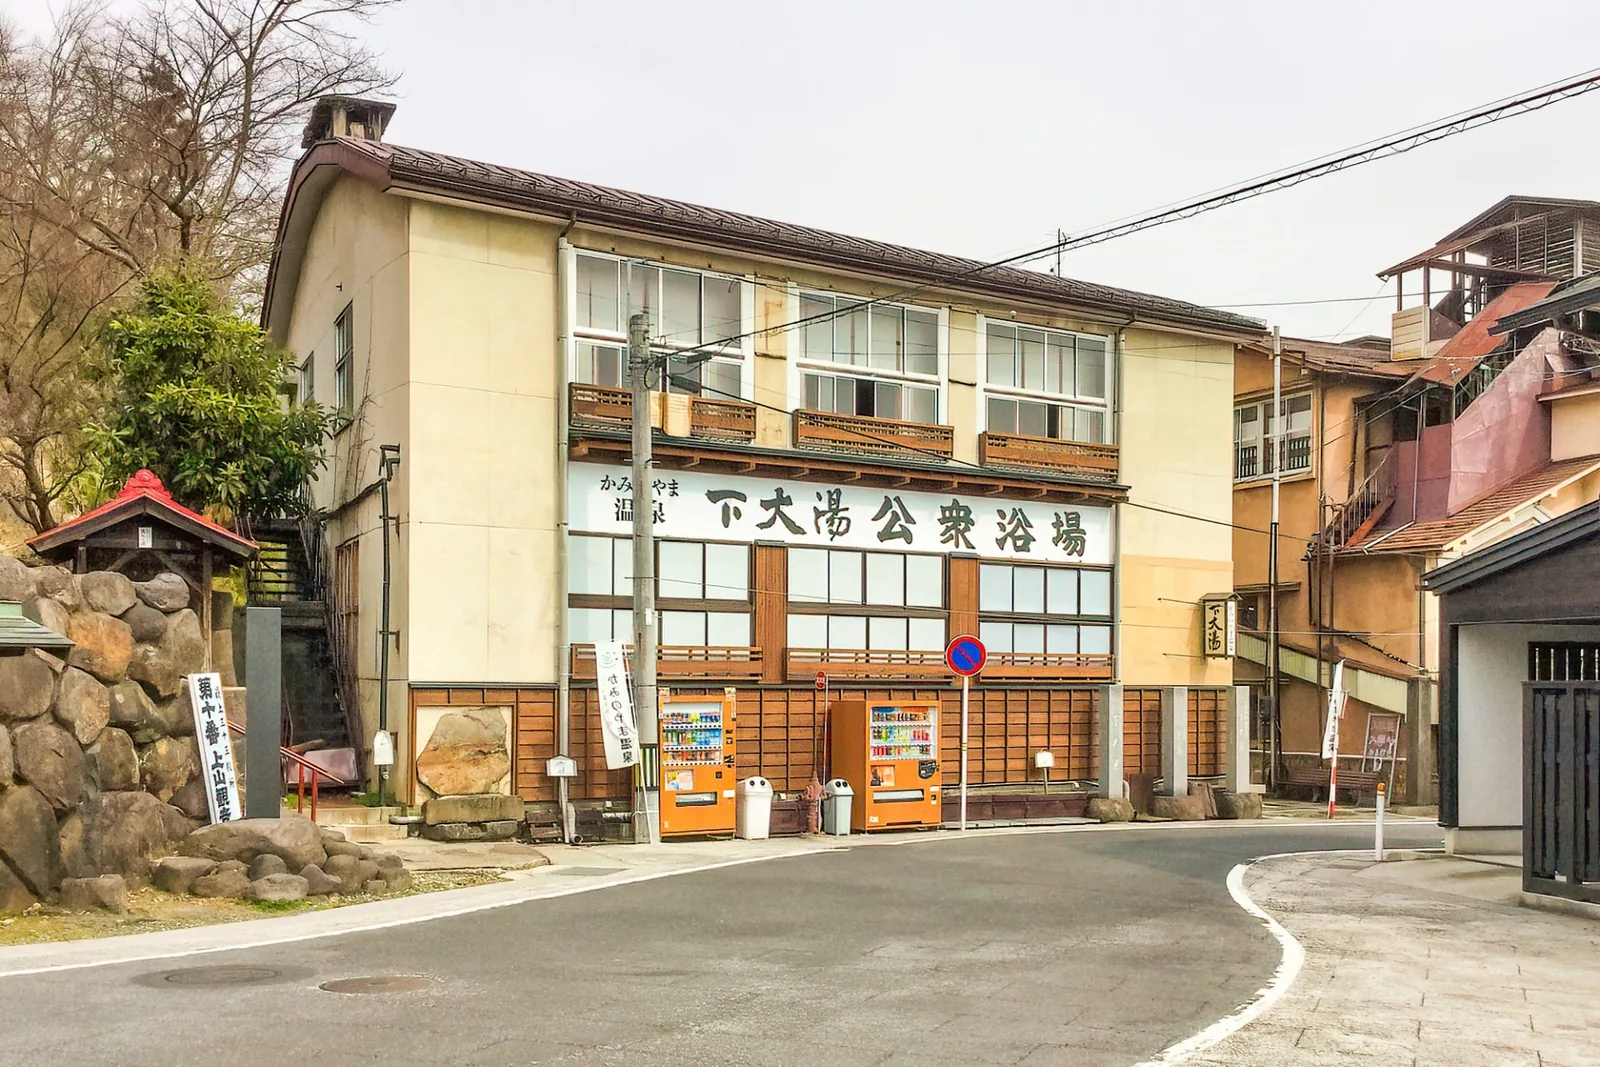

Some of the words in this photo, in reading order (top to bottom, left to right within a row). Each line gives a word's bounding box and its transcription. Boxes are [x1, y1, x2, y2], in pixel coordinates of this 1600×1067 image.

[600, 474, 680, 497] かみやま
[704, 486, 1087, 557] 下大湯公衆浴場
[1208, 604, 1223, 652] 下大湯
